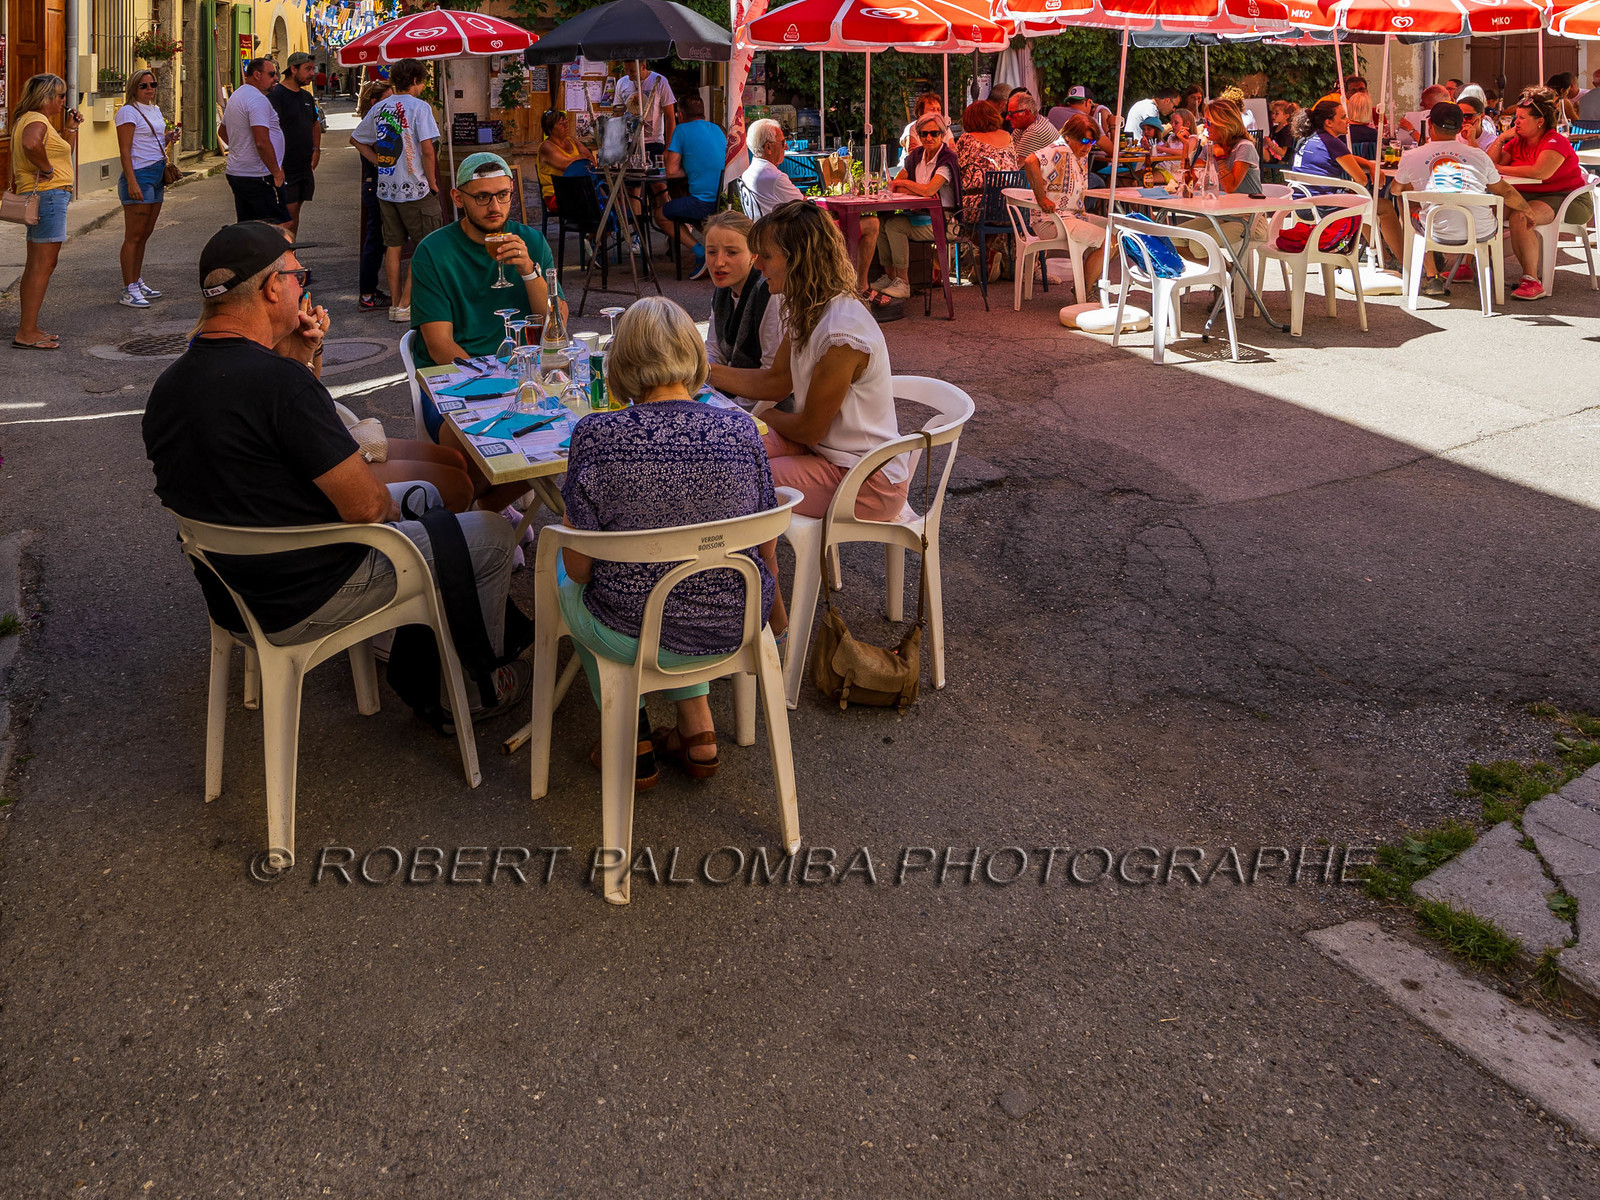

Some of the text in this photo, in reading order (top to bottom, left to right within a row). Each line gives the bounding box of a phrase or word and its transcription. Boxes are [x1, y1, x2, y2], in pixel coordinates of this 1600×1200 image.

[1291, 9, 1310, 19] MIKO
[1491, 16, 1510, 25] MIKO
[416, 44, 436, 53] MIKO
[700, 534, 724, 543] VERDON
[698, 541, 725, 551] BOISSONS
